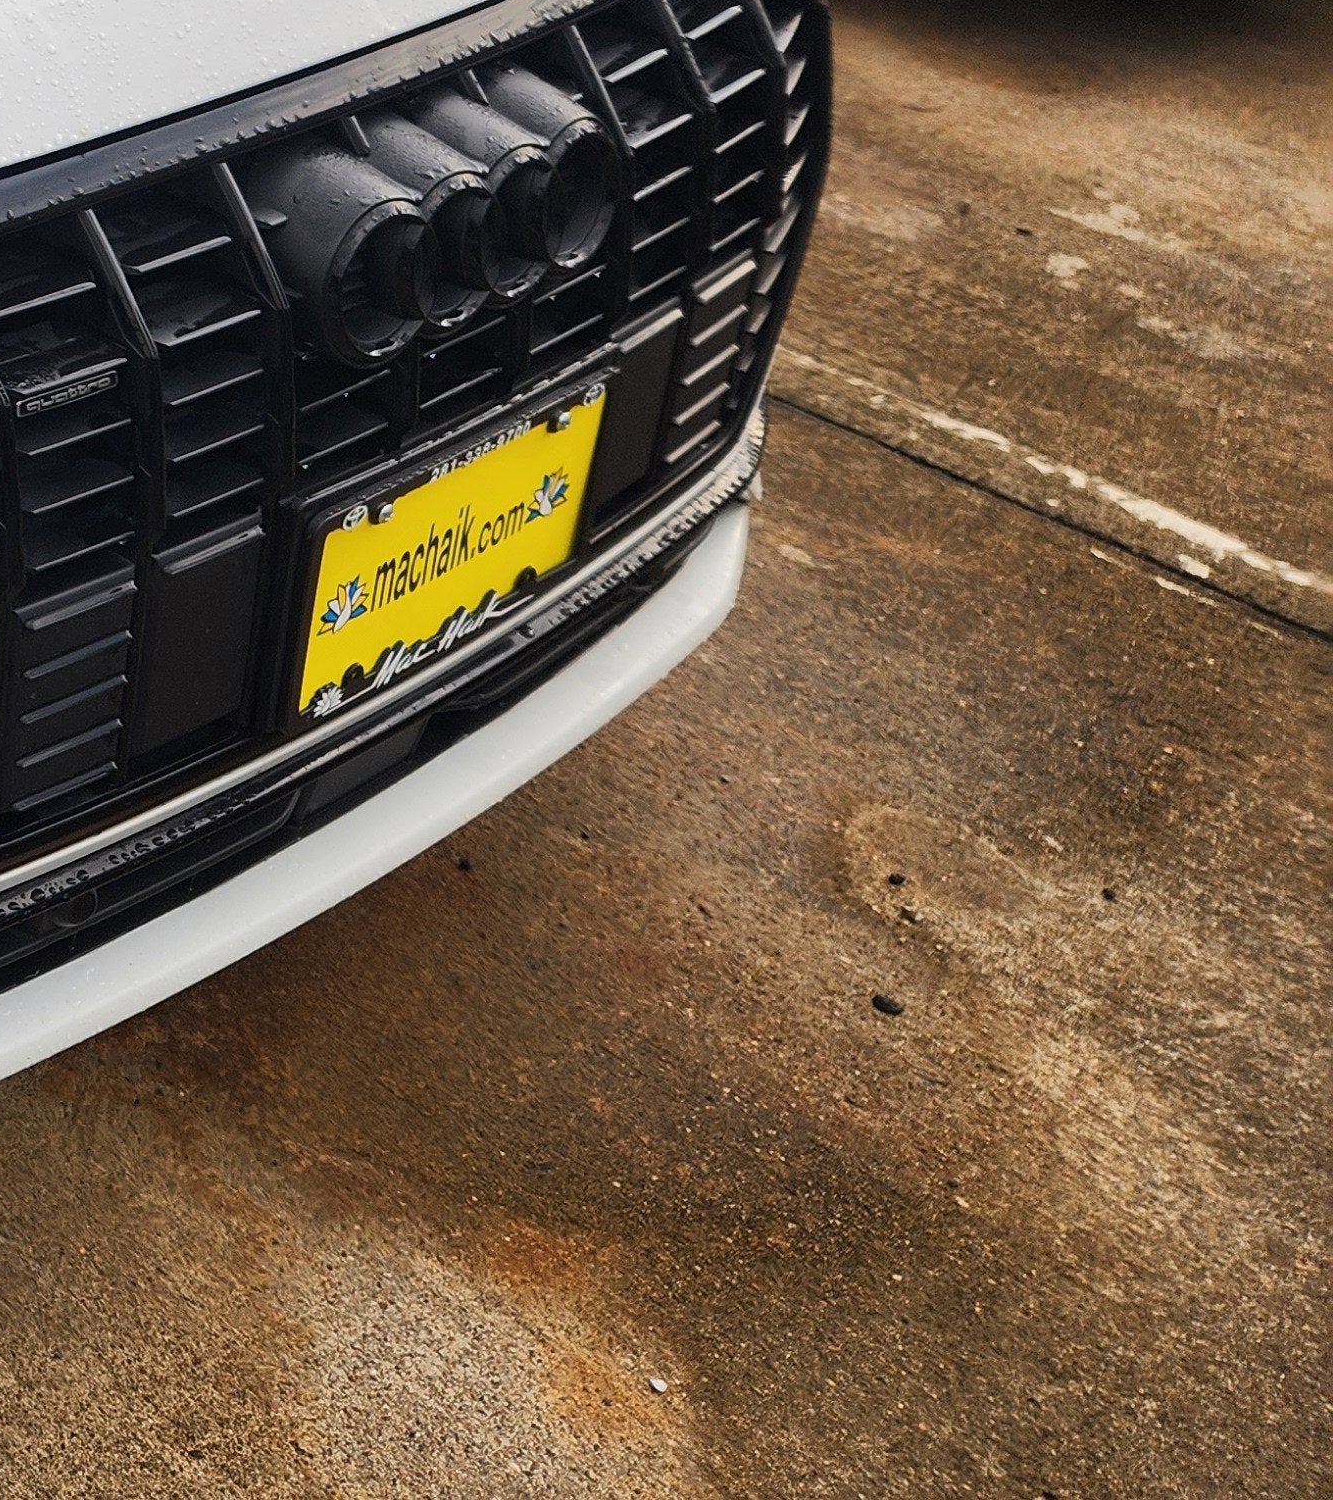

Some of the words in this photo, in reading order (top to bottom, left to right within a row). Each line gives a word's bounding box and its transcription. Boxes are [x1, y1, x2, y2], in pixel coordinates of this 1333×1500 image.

[26, 377, 111, 411] quattro
[370, 505, 527, 612] machaik.com
[374, 646, 436, 688] Mac
[437, 593, 519, 652] Haik
